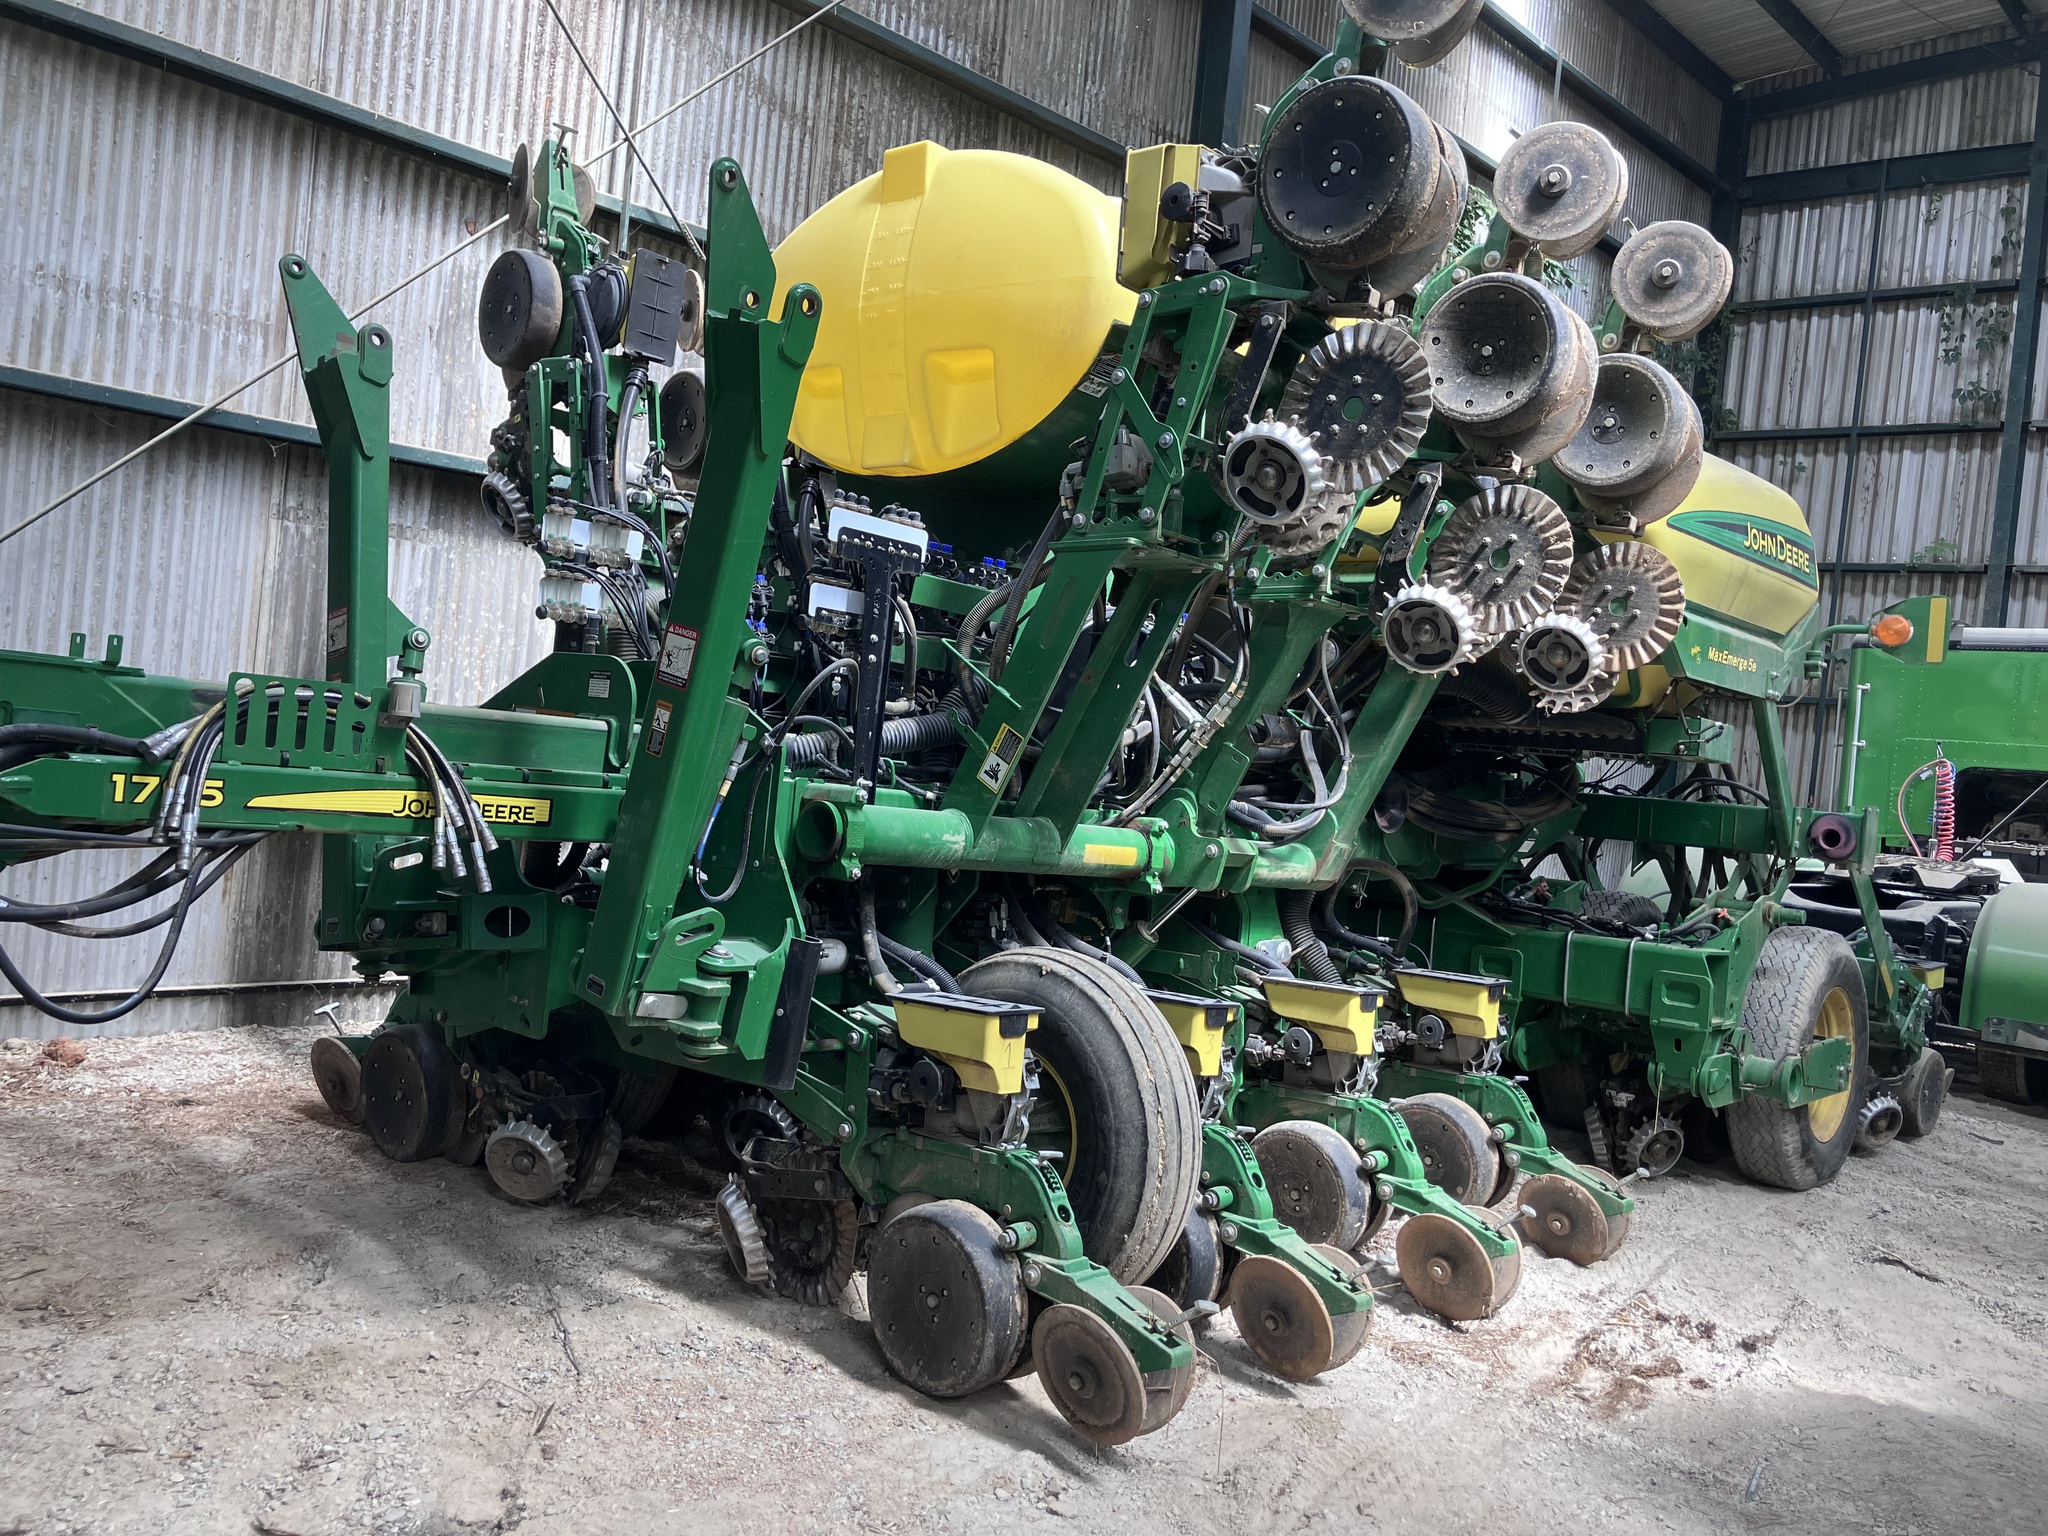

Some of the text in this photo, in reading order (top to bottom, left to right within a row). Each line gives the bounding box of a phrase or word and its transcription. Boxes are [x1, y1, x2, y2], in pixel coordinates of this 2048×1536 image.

[1743, 521, 1811, 574] JOHN DEERE
[674, 626, 698, 639] DANGER
[1707, 645, 1748, 671] MaxEmerge
[1747, 657, 1758, 673] 5e
[995, 725, 1008, 746] CAUTION
[110, 772, 225, 808] 175
[392, 794, 438, 816] JOH
[1002, 1041, 1015, 1070] 1
[1204, 1033, 1215, 1055] 3
